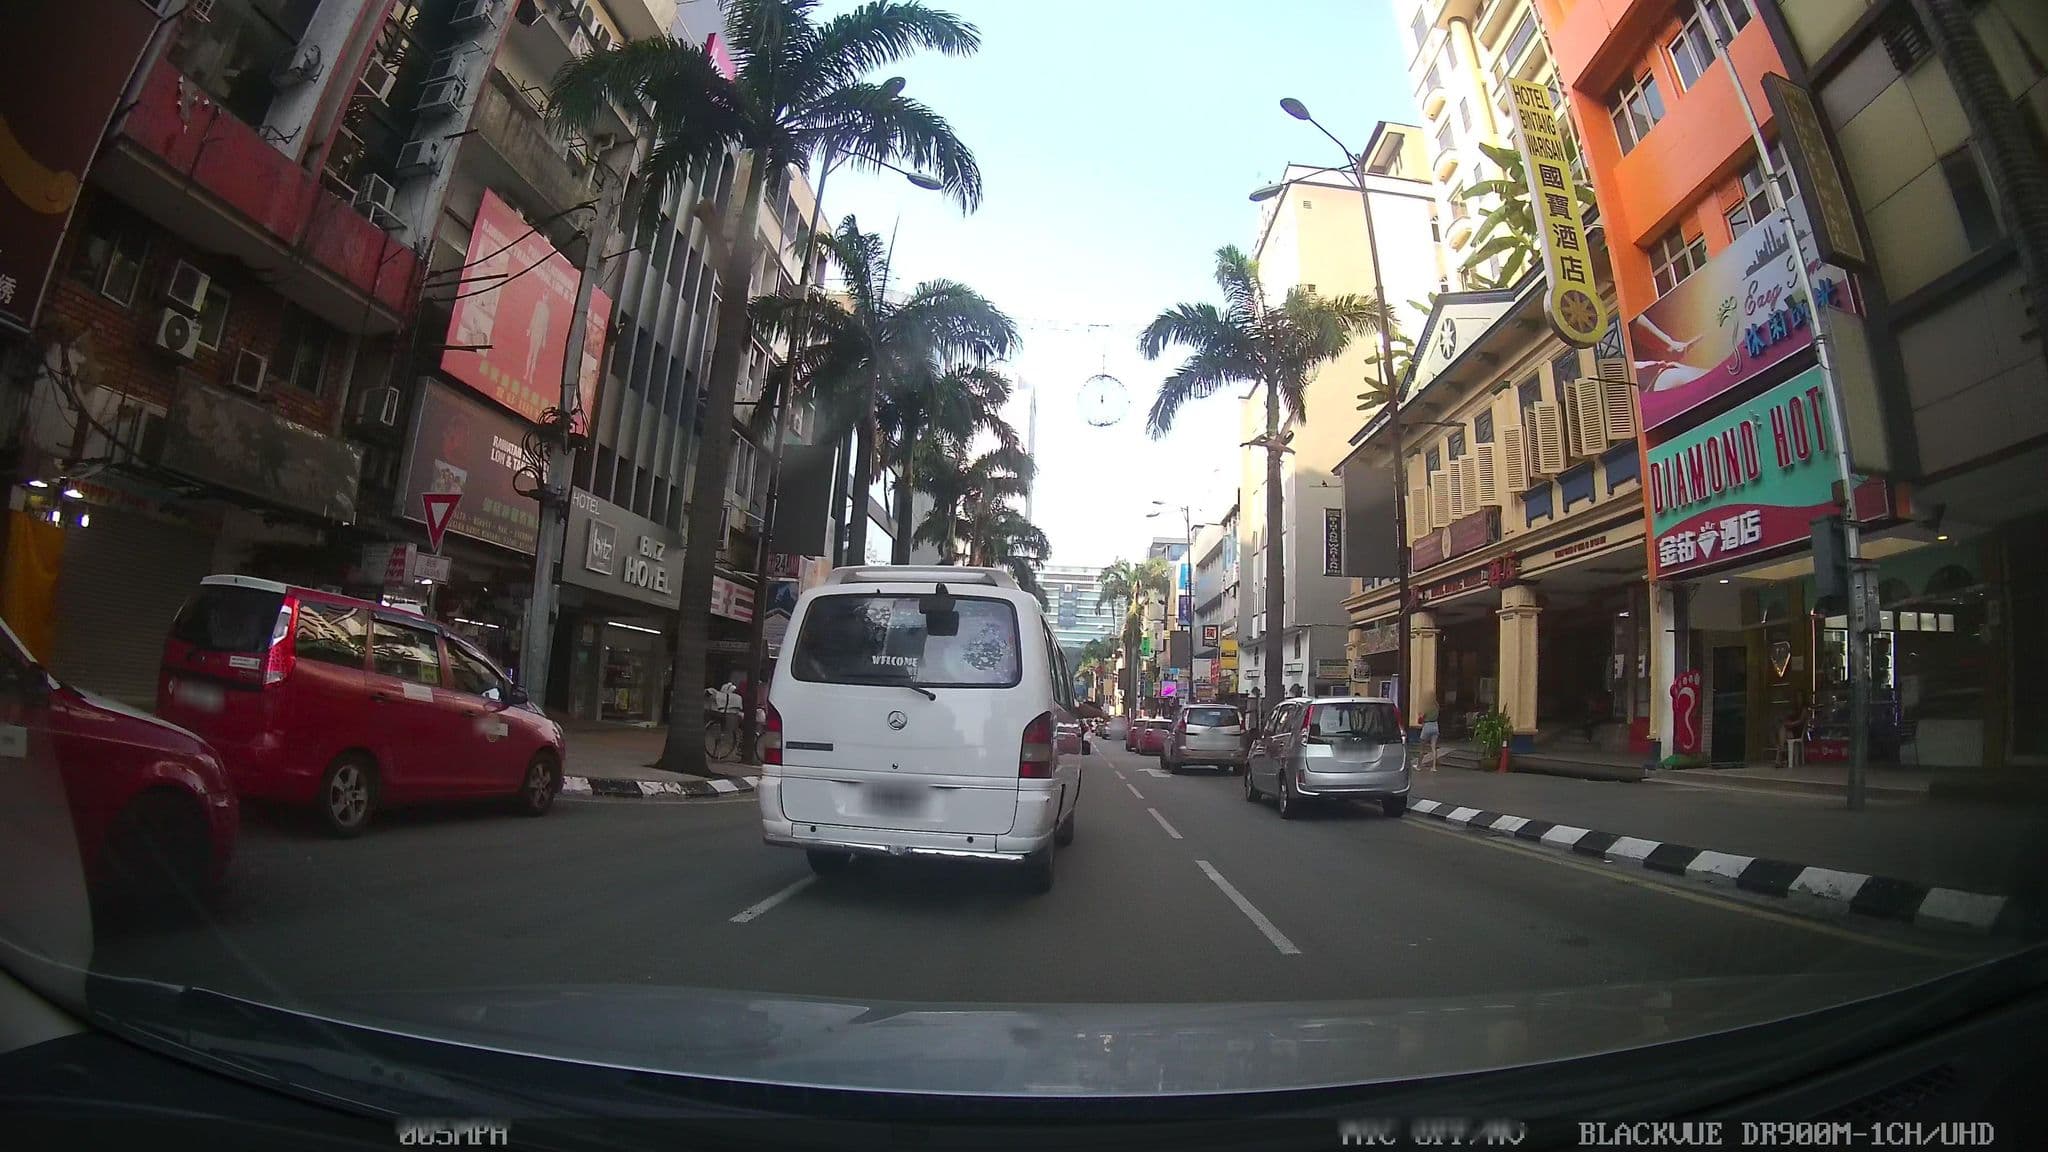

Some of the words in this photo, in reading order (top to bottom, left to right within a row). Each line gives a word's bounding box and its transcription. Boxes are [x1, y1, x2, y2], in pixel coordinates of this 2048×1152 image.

[1512, 84, 1549, 111] HOTEL
[1519, 108, 1556, 136] BINTANG
[1524, 133, 1566, 161] WARISAN
[1538, 164, 1586, 284] 國寶酒店
[1745, 280, 1783, 316] Easy
[1650, 419, 1761, 515] DIAMOND
[572, 491, 600, 515] HOTEL
[1720, 509, 1762, 552] 酒店
[871, 655, 919, 667] WELCOME
